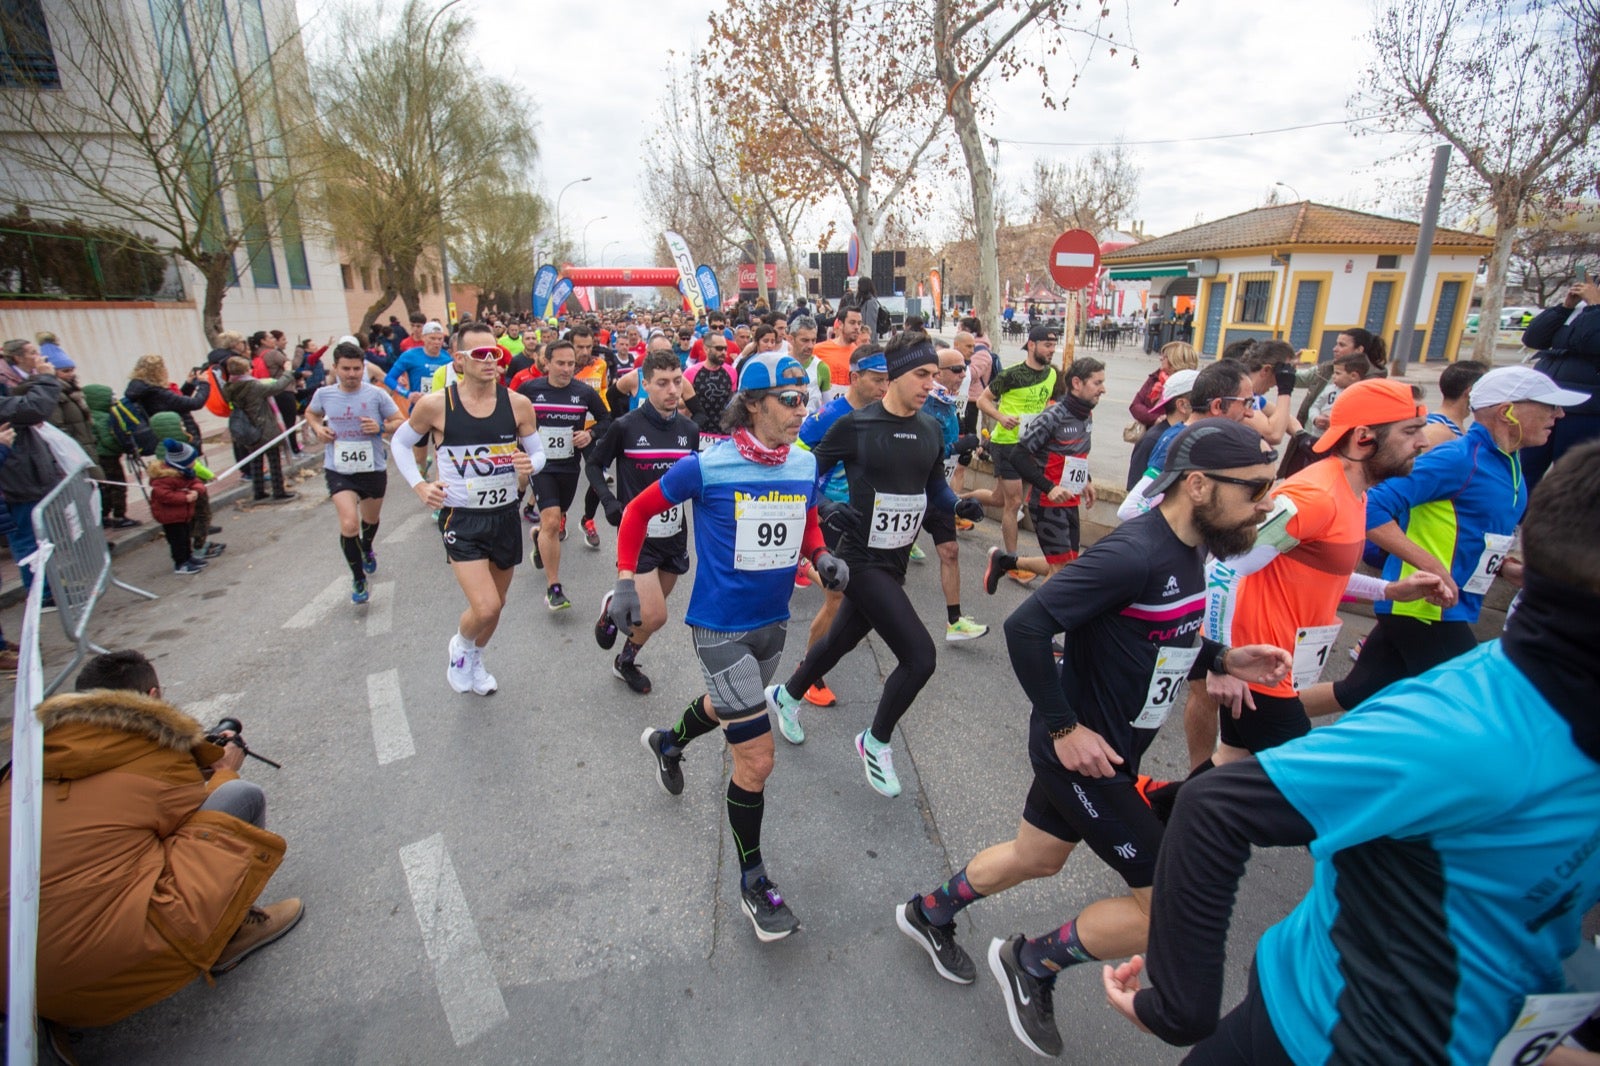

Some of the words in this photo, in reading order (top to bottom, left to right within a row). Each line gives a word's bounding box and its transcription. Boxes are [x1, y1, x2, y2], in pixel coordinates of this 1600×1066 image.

[548, 437, 565, 448] 28
[341, 451, 367, 463] 546
[1069, 469, 1086, 483] 180
[477, 488, 508, 506] 732
[875, 512, 921, 533] 3131
[757, 523, 788, 547] 99
[1316, 645, 1329, 667] 1
